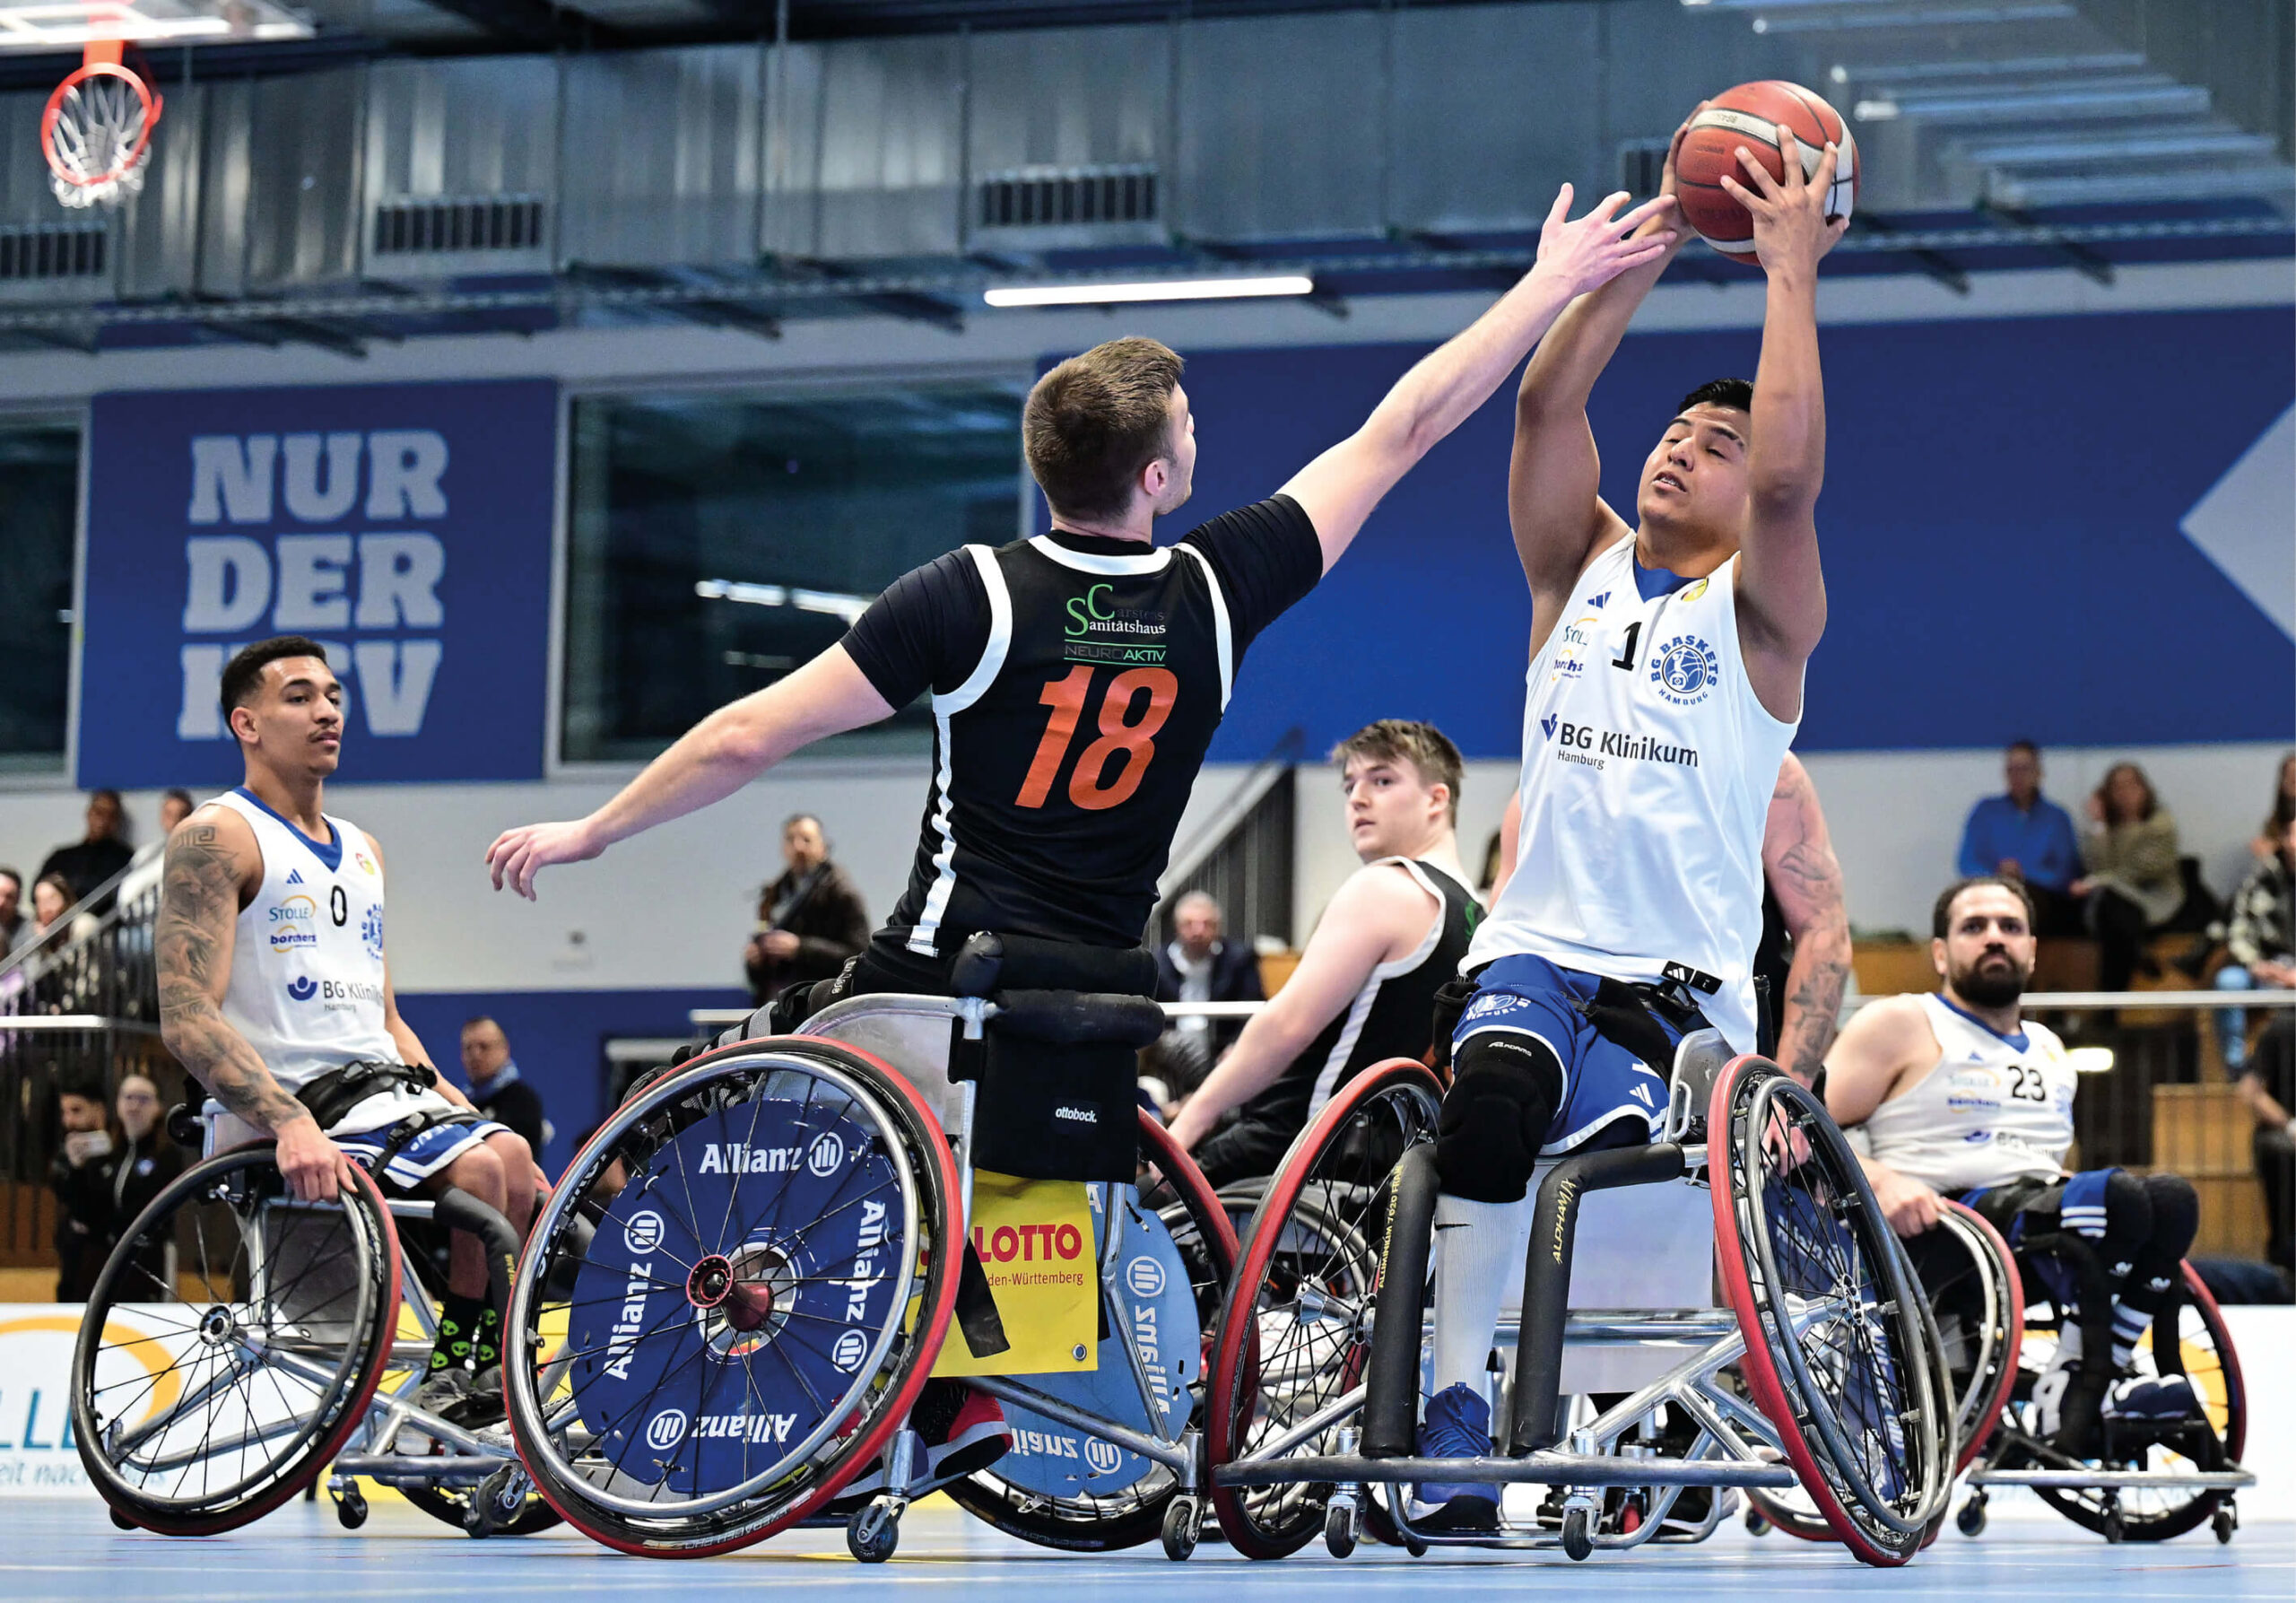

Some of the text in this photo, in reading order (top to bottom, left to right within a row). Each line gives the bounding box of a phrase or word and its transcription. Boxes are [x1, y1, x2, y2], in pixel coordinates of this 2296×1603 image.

[187, 429, 448, 525] NUR
[182, 531, 446, 634] DER
[1612, 622, 1642, 671] 1
[1651, 635, 1718, 686] BG BASKETS
[1658, 689, 1709, 705] HAMBURG
[1014, 665, 1178, 810] 18
[1560, 722, 1699, 767] BG Klinikum
[1557, 749, 1605, 771] Hamburg
[330, 885, 347, 927] 0
[323, 981, 344, 998] BG
[2008, 1065, 2046, 1102] 23
[699, 1144, 803, 1174] Allianz
[846, 1199, 886, 1322] Allianz
[974, 1224, 1083, 1262] LOTTO
[987, 1271, 1083, 1286] den-Württemberg
[597, 1262, 652, 1381] Allianz
[691, 1413, 797, 1443] Allianz
